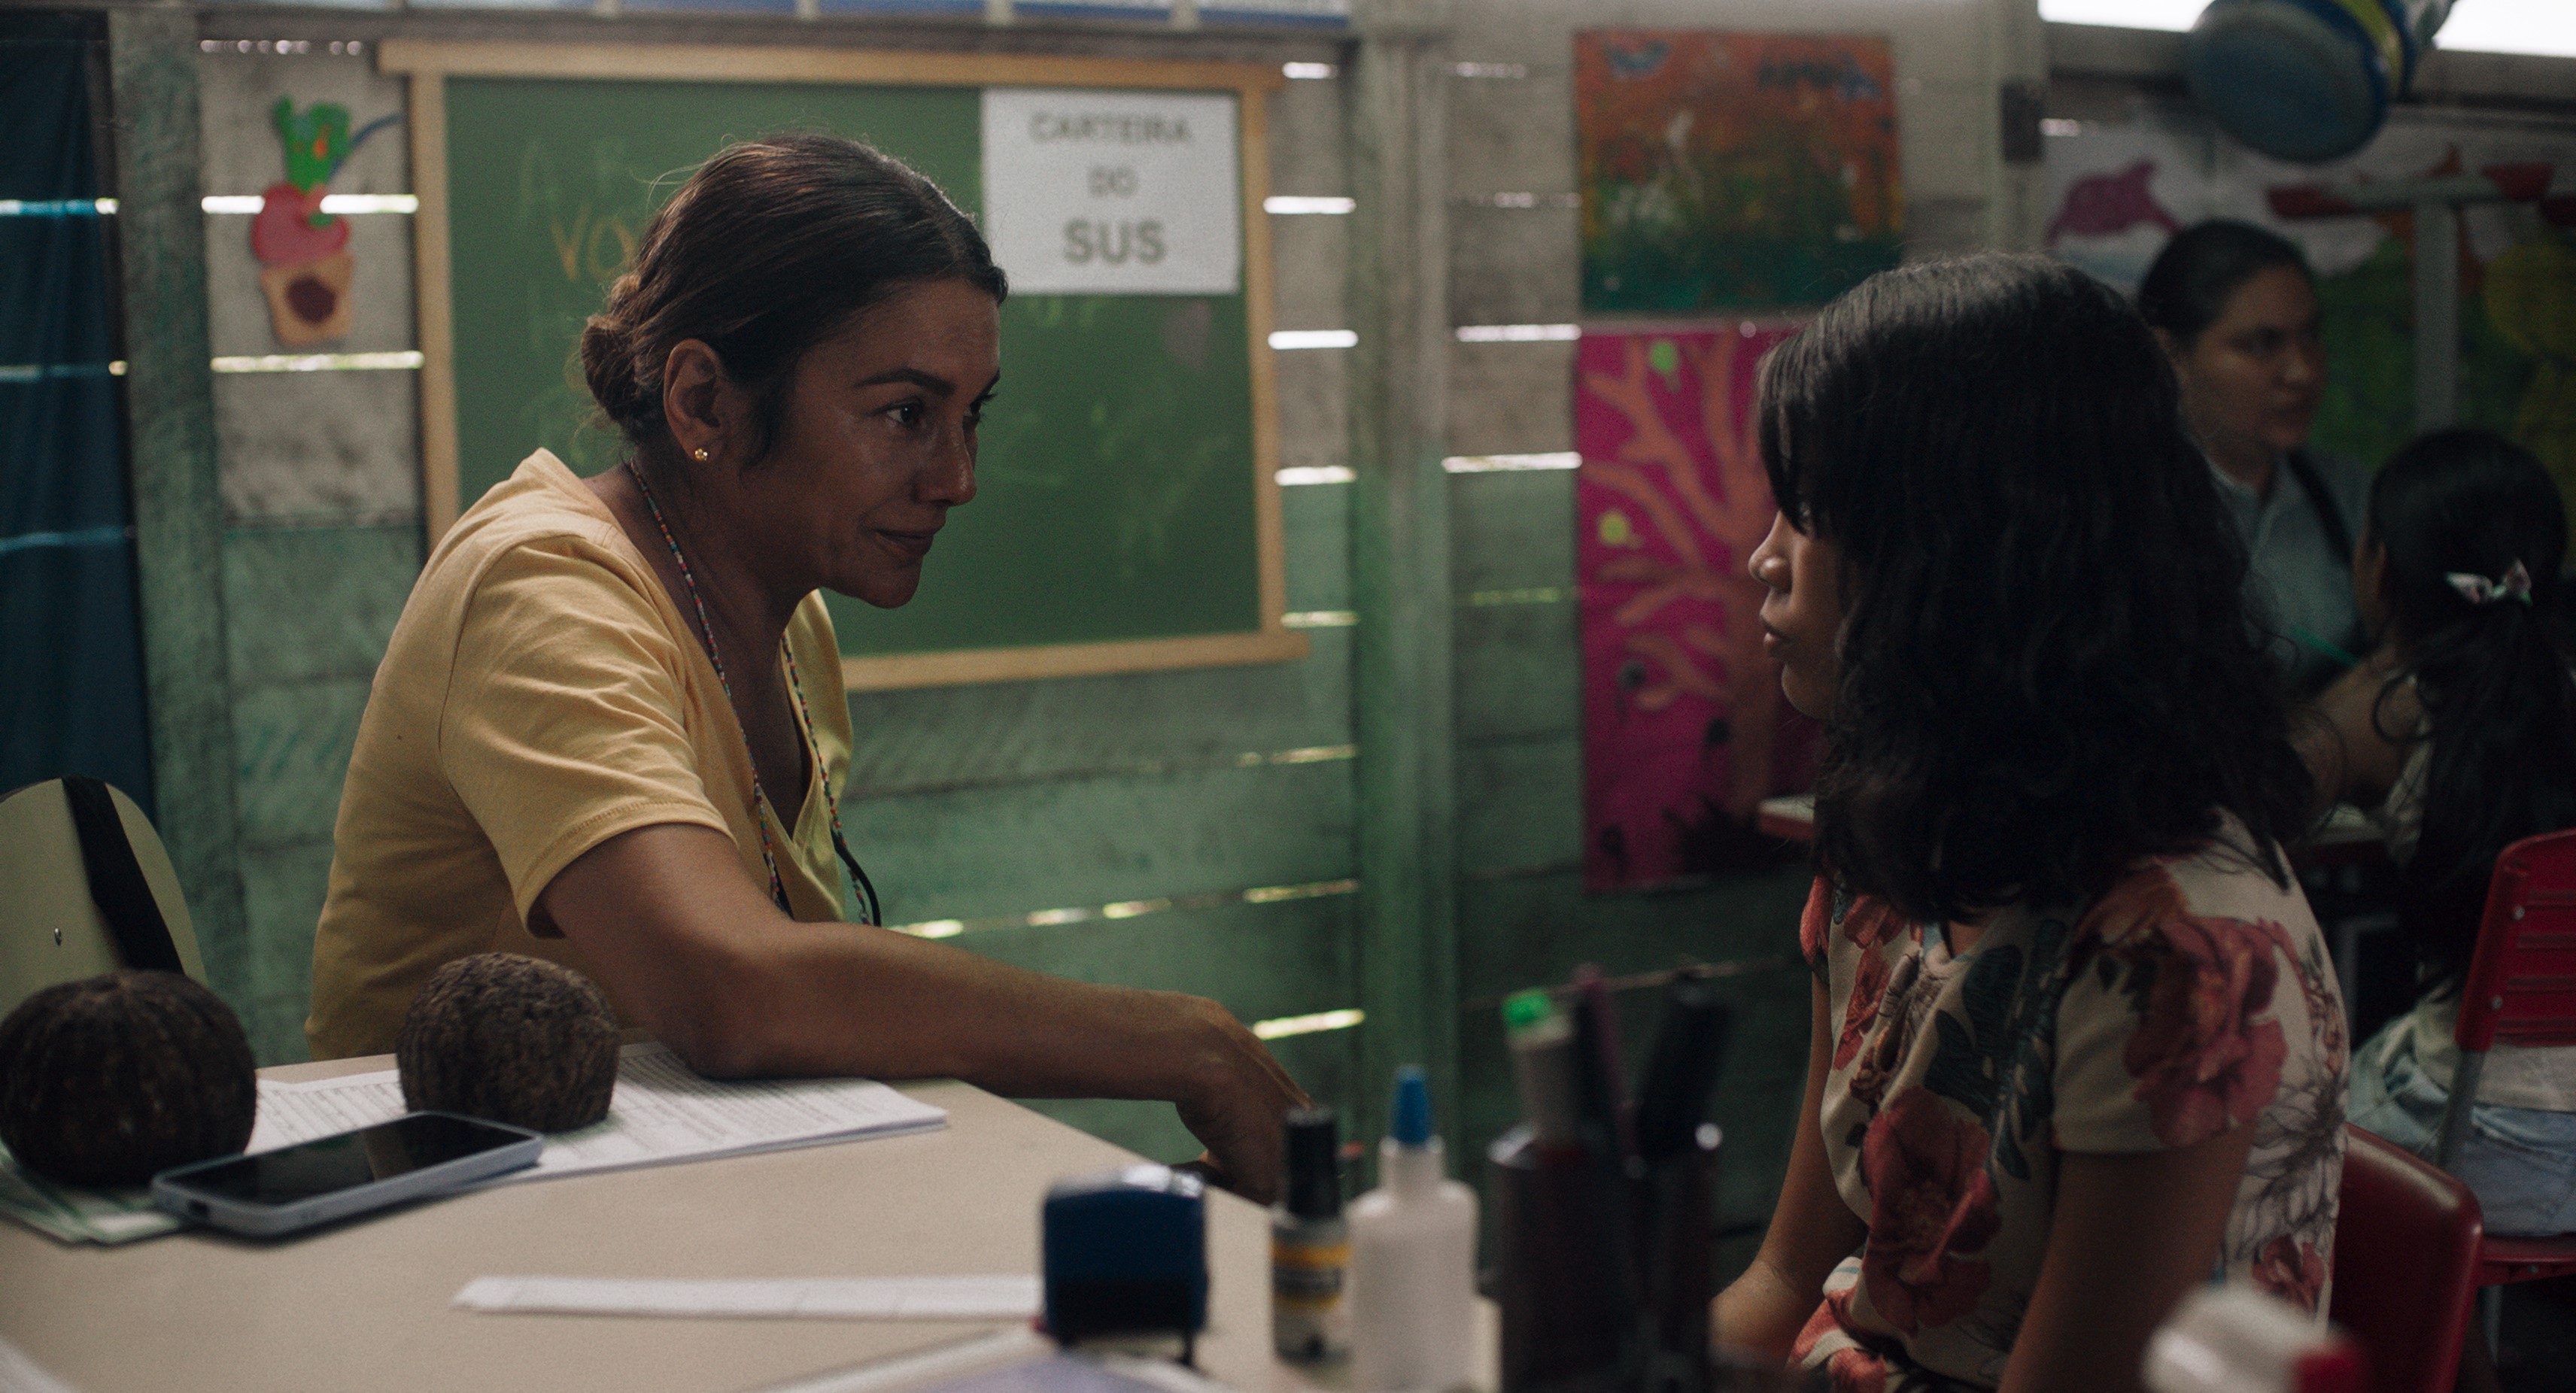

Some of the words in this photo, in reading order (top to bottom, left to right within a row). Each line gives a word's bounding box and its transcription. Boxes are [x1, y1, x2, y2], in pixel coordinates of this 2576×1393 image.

[1028, 111, 1189, 144] CARTEIRA
[1088, 165, 1140, 198] DO
[1063, 219, 1168, 266] SUS
